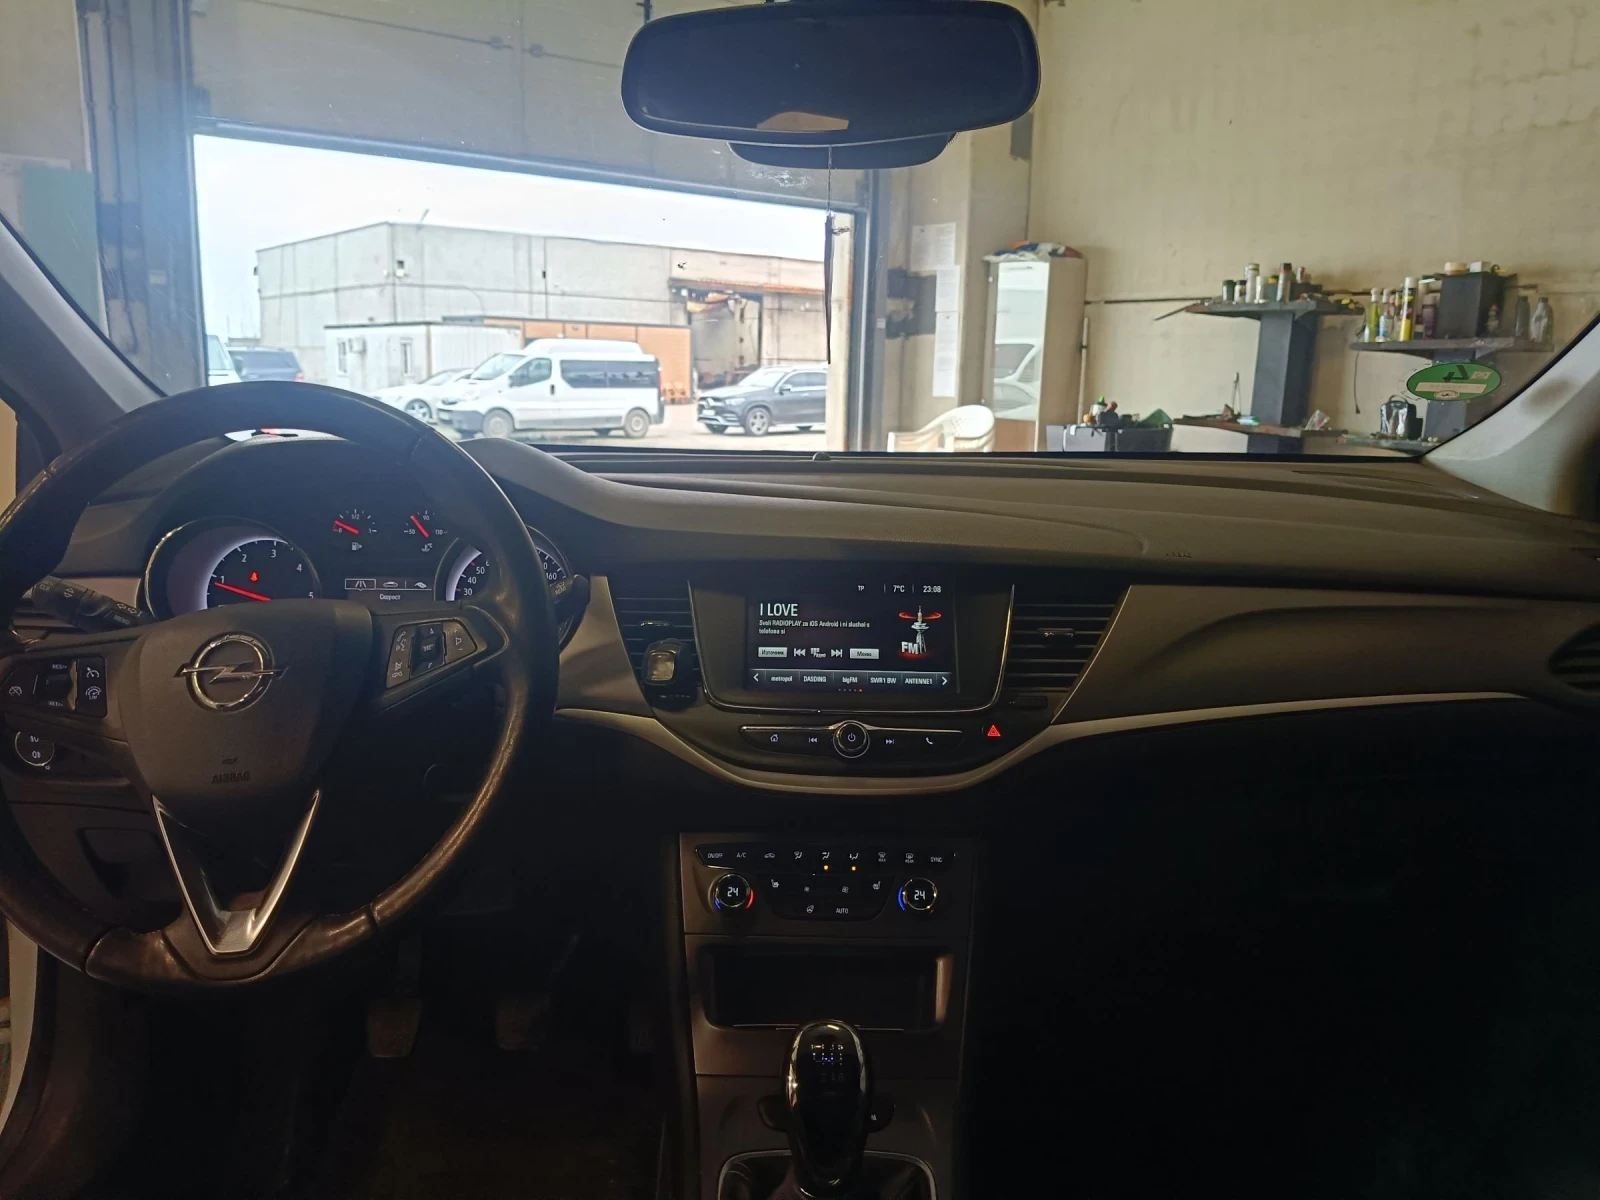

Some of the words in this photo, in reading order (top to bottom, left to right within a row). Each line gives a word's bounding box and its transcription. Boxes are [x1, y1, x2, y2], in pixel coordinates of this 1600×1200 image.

[270, 549, 277, 558] 3
[241, 554, 247, 563] 2
[296, 563, 302, 572] 4
[476, 566, 485, 575] 50
[220, 575, 225, 584] 1
[467, 576, 477, 585] 40
[546, 572, 558, 580] 160
[463, 588, 473, 596] 30
[923, 585, 942, 593] 23:08
[760, 603, 763, 616] I
[767, 603, 799, 617] LOVE
[901, 641, 919, 655] FM
[770, 675, 793, 683] metropol
[803, 675, 827, 683] DASDING
[842, 676, 858, 684] bigFM
[870, 676, 886, 684] SWR1
[727, 886, 739, 897] 24
[914, 889, 926, 900] 24
